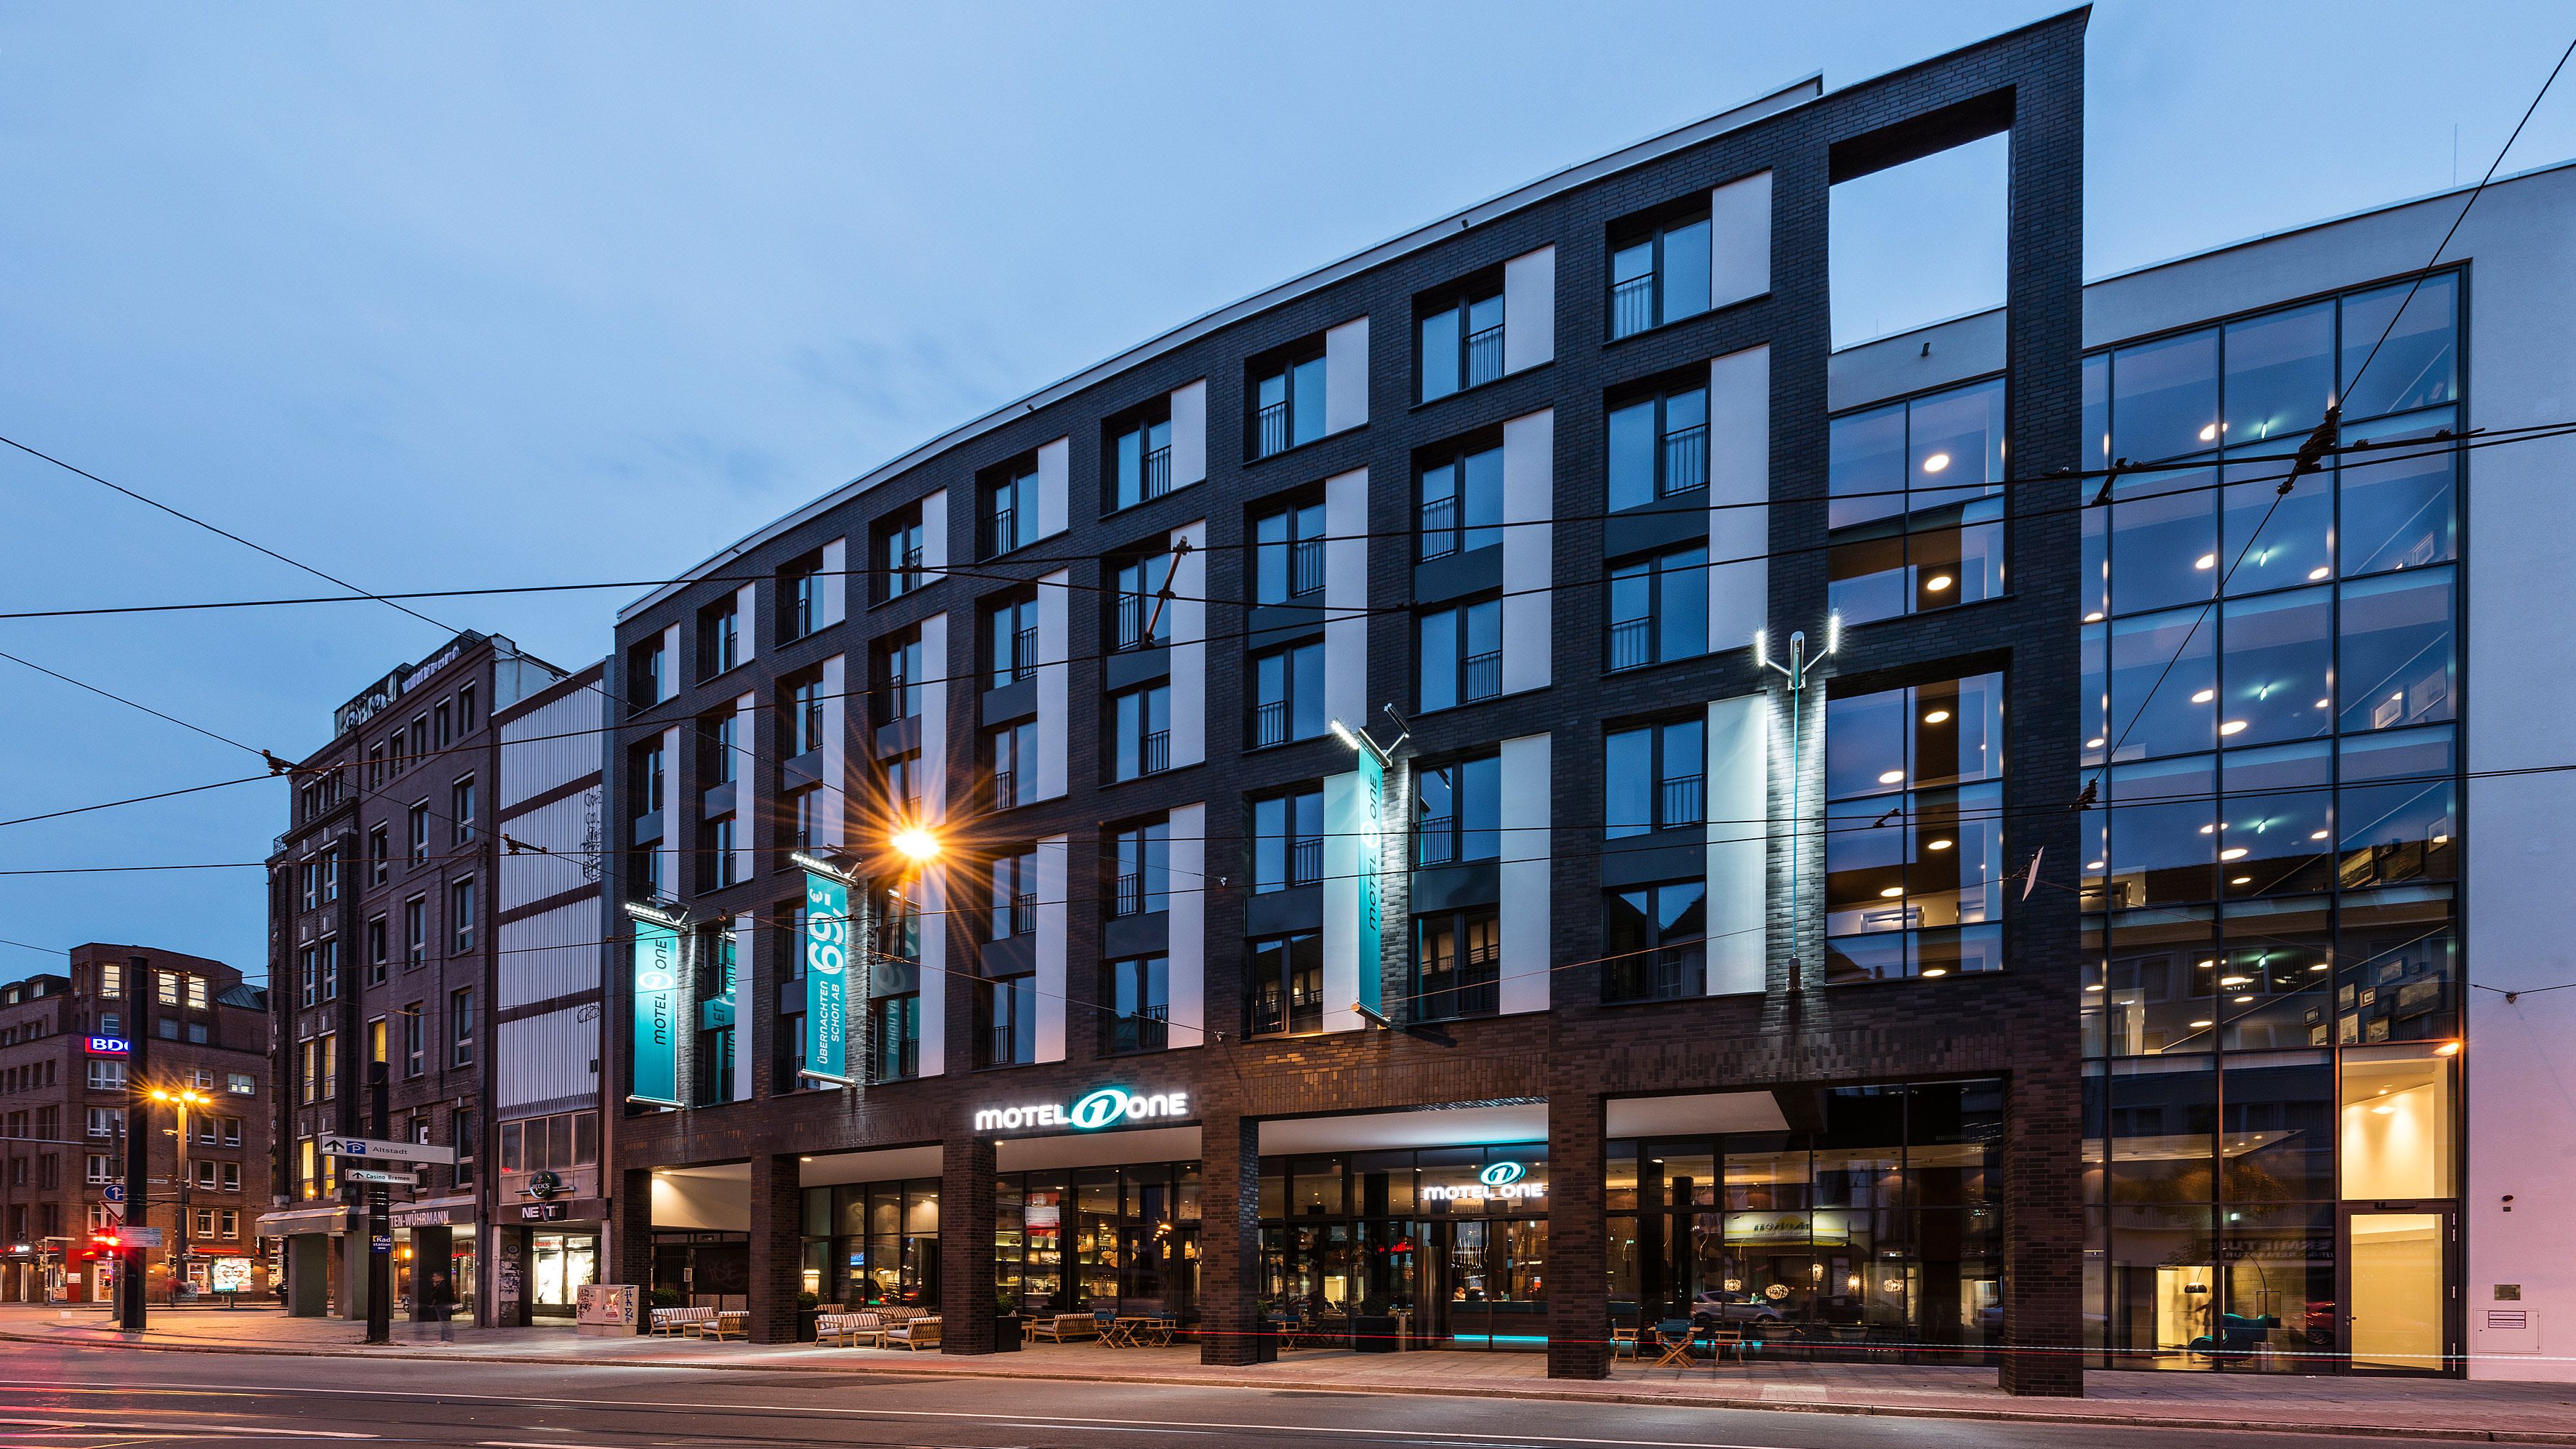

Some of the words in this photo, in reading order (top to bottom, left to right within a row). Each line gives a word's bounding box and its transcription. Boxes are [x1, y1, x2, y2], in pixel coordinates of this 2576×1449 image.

[655, 939, 667, 970] ONE
[832, 984, 840, 1000] AB
[654, 993, 667, 1045] MOTEL
[817, 981, 828, 1064] ÜBERNACHTEN
[831, 1003, 840, 1043] SCHON
[975, 1104, 1072, 1131] MOTEL
[1126, 1093, 1189, 1118] ONE
[1423, 1185, 1496, 1200] MOTEL
[1500, 1183, 1544, 1198] ONE
[522, 1200, 555, 1221] NEXT
